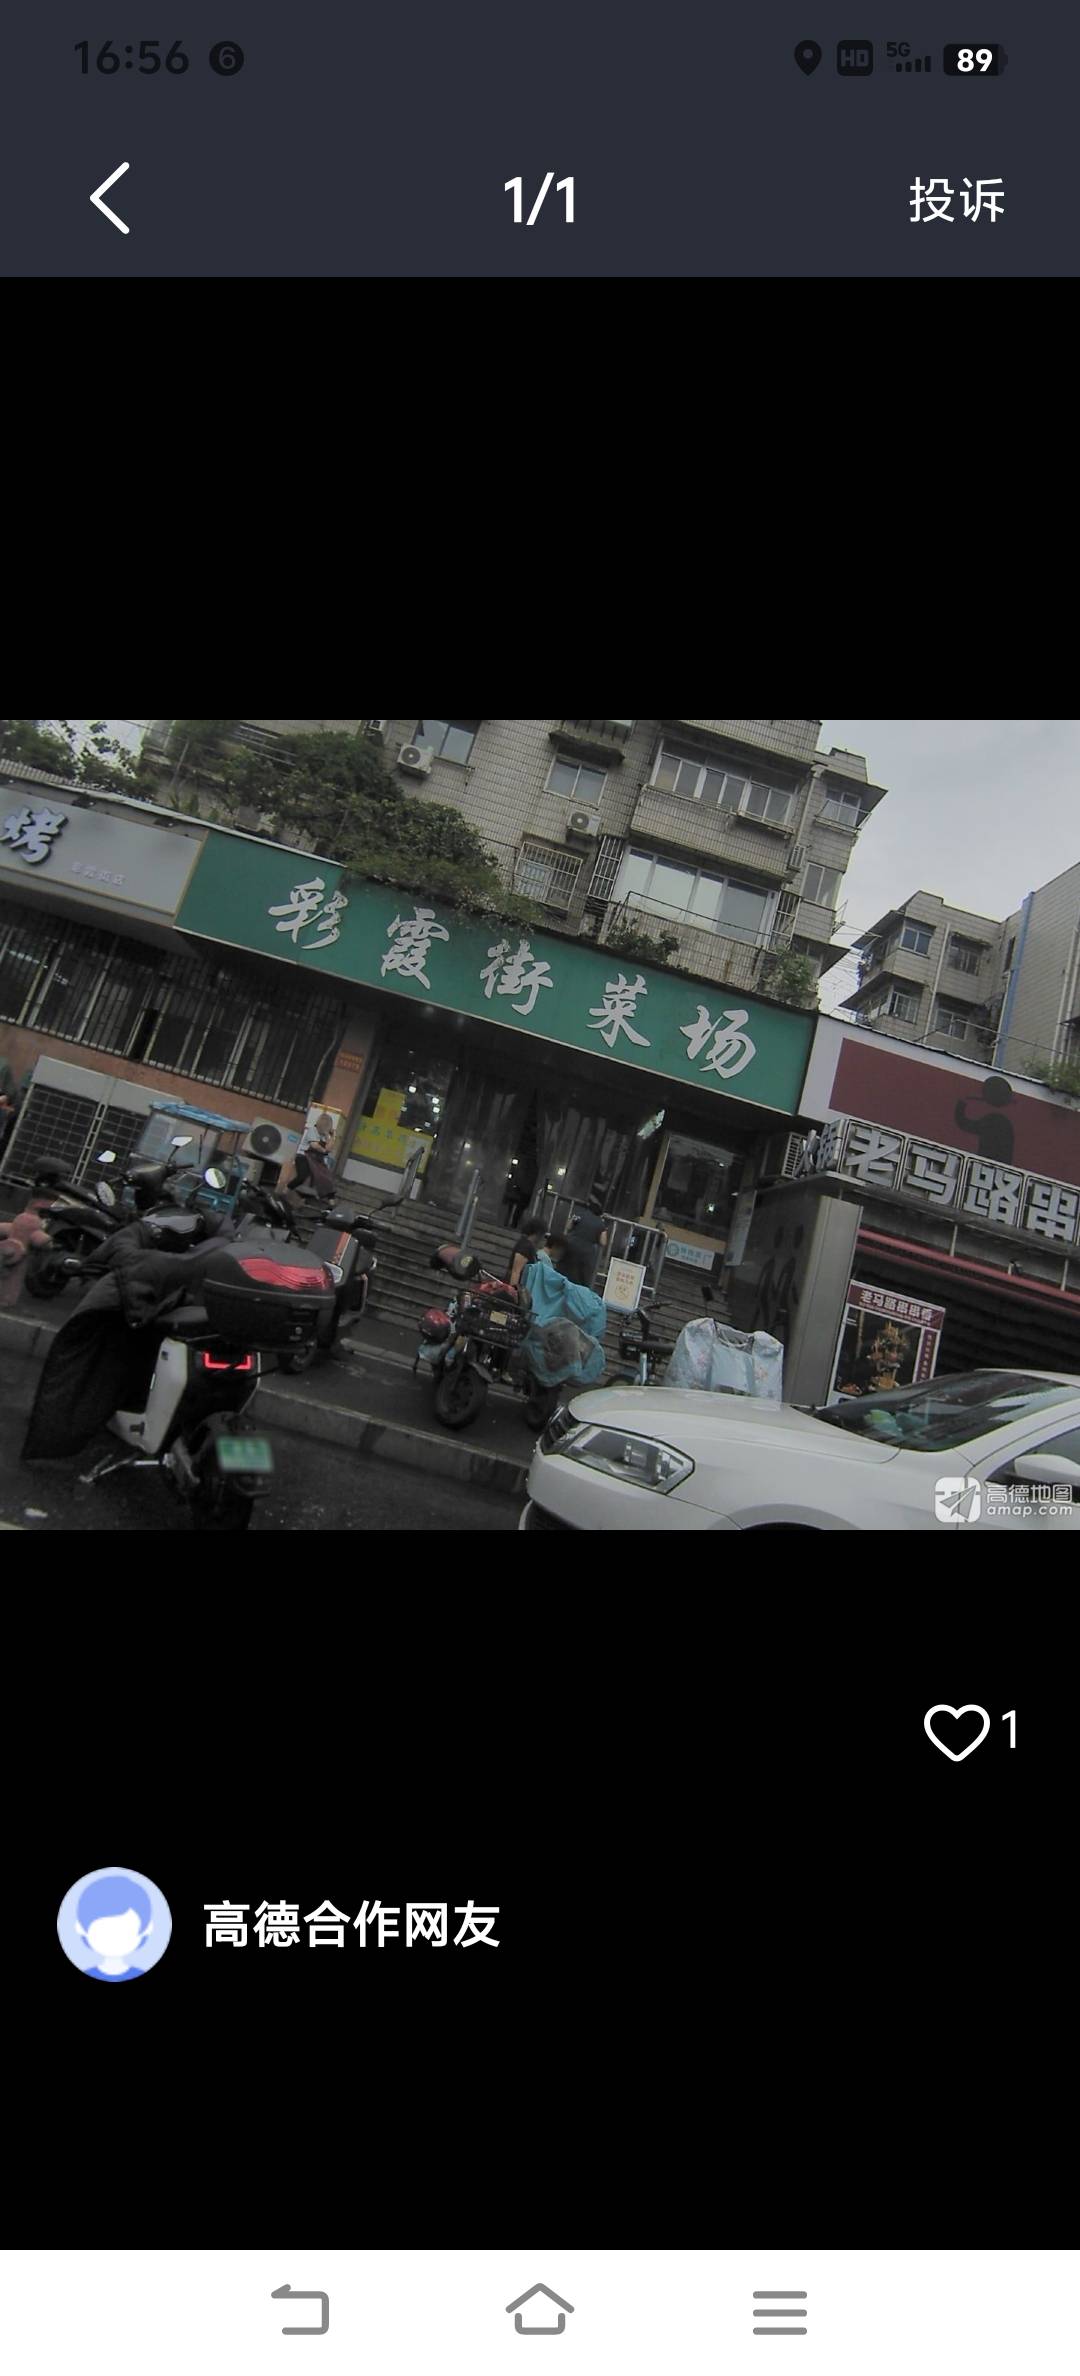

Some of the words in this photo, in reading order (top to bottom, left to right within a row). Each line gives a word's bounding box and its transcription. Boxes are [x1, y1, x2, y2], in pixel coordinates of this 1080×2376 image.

[0, 808, 66, 863] 烤
[268, 877, 757, 1079] 彩霞街菜场
[845, 1124, 1080, 1241] 老马路串
